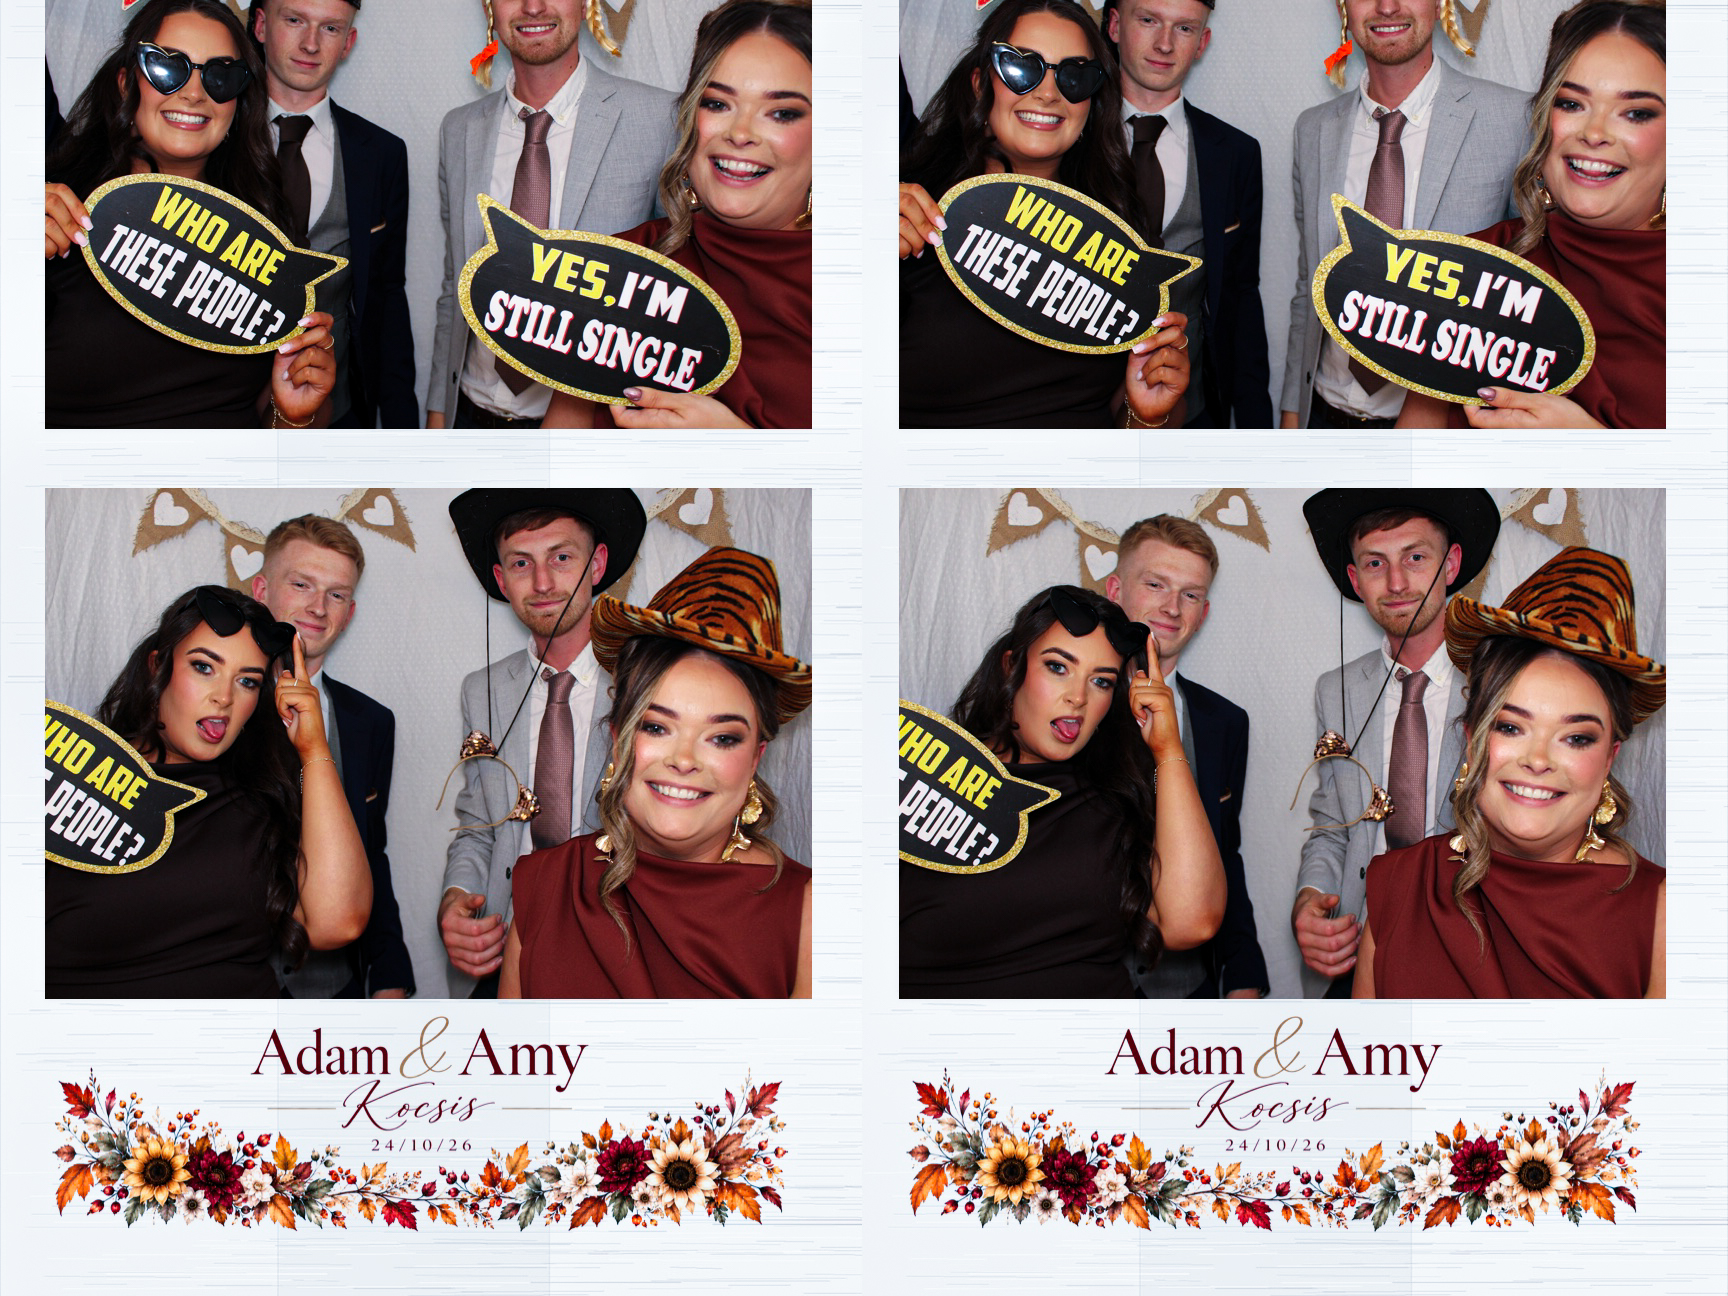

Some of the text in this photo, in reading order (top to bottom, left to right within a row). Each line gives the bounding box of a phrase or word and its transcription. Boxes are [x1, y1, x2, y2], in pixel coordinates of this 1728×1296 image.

[151, 185, 286, 287] WHO ARE
[531, 242, 689, 324] YES, I'M
[1005, 185, 1140, 287] WHO ARE
[1385, 242, 1543, 324] YES, I'M
[100, 223, 286, 346] THESE PEOPLE?
[954, 223, 1140, 346] THESE PEOPLE?
[484, 290, 703, 392] STILL SINGLE
[1338, 290, 1557, 392] STILL SINGLE
[45, 779, 146, 866] PEOPLE?
[84, 755, 149, 811] ARE
[899, 779, 1000, 866] PEOPLE?
[938, 755, 1003, 811] ARE
